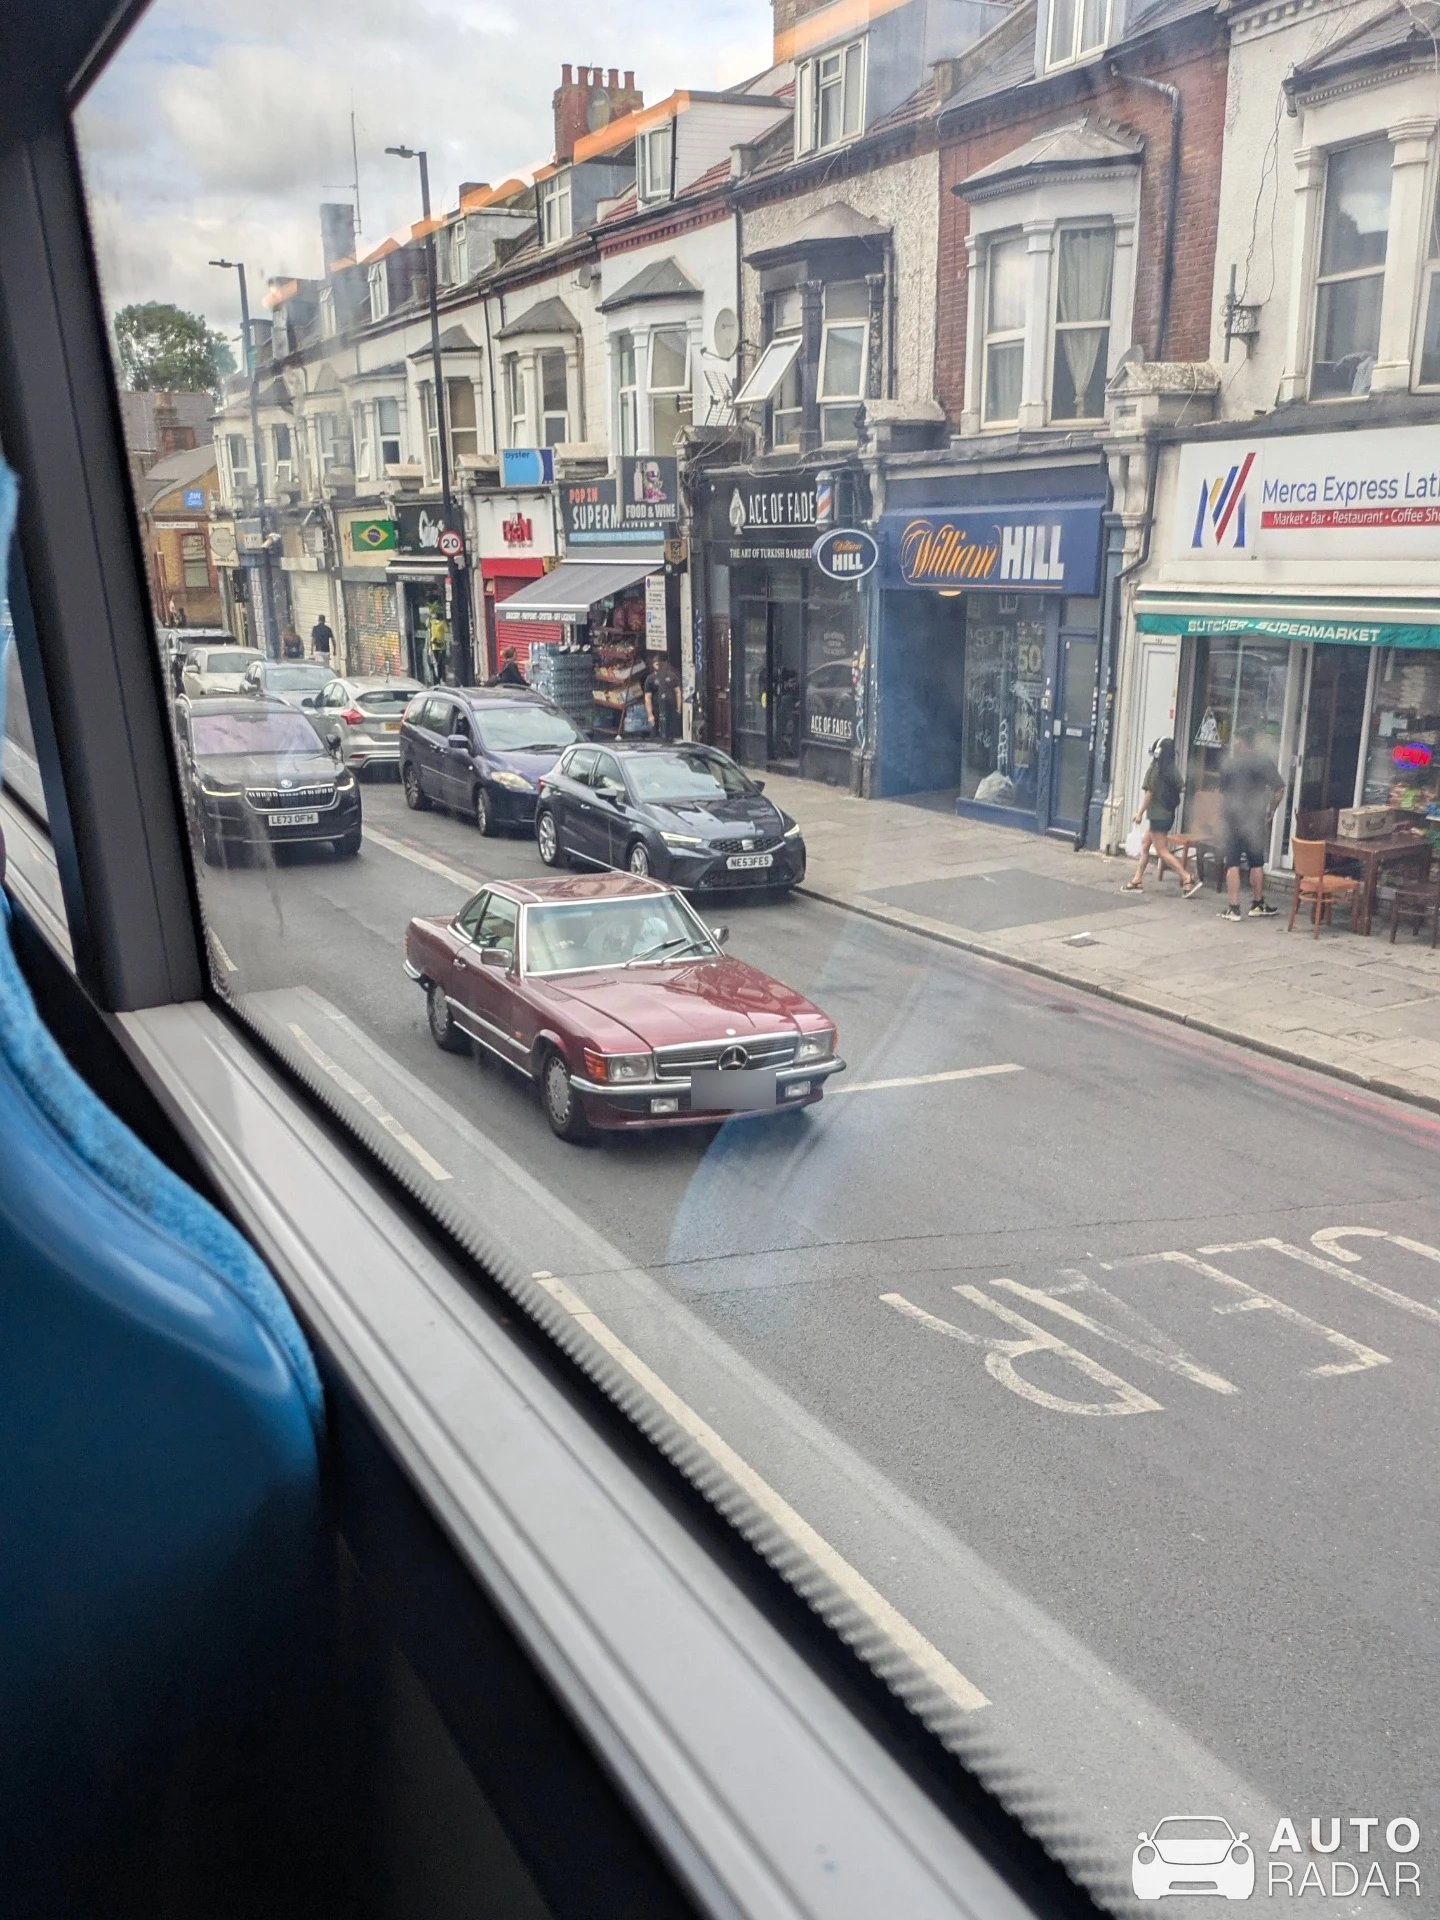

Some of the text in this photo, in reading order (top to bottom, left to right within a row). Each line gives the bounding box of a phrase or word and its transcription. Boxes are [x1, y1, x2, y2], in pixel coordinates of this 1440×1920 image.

[504, 451, 530, 461] oyster
[569, 488, 585, 504] POP
[1262, 478, 1318, 504] Merca
[1323, 475, 1399, 508] Express
[625, 503, 676, 519] FOOD & WINE
[749, 490, 816, 524] ACE OF FADE
[1273, 512, 1304, 525] Market
[1310, 511, 1326, 525] Bar
[1332, 509, 1384, 525] Restaurant
[1390, 507, 1423, 523] Coffee
[443, 538, 459, 549] 20
[901, 519, 1064, 580] William HILL
[730, 547, 812, 560] THE ART OF TURKISH BARBERI
[832, 553, 863, 571] HILL
[1255, 624, 1381, 642] SUPERMARKET
[811, 715, 852, 737] ACE OF FADES
[1393, 745, 1431, 766] OPEN
[271, 815, 292, 824] LE73
